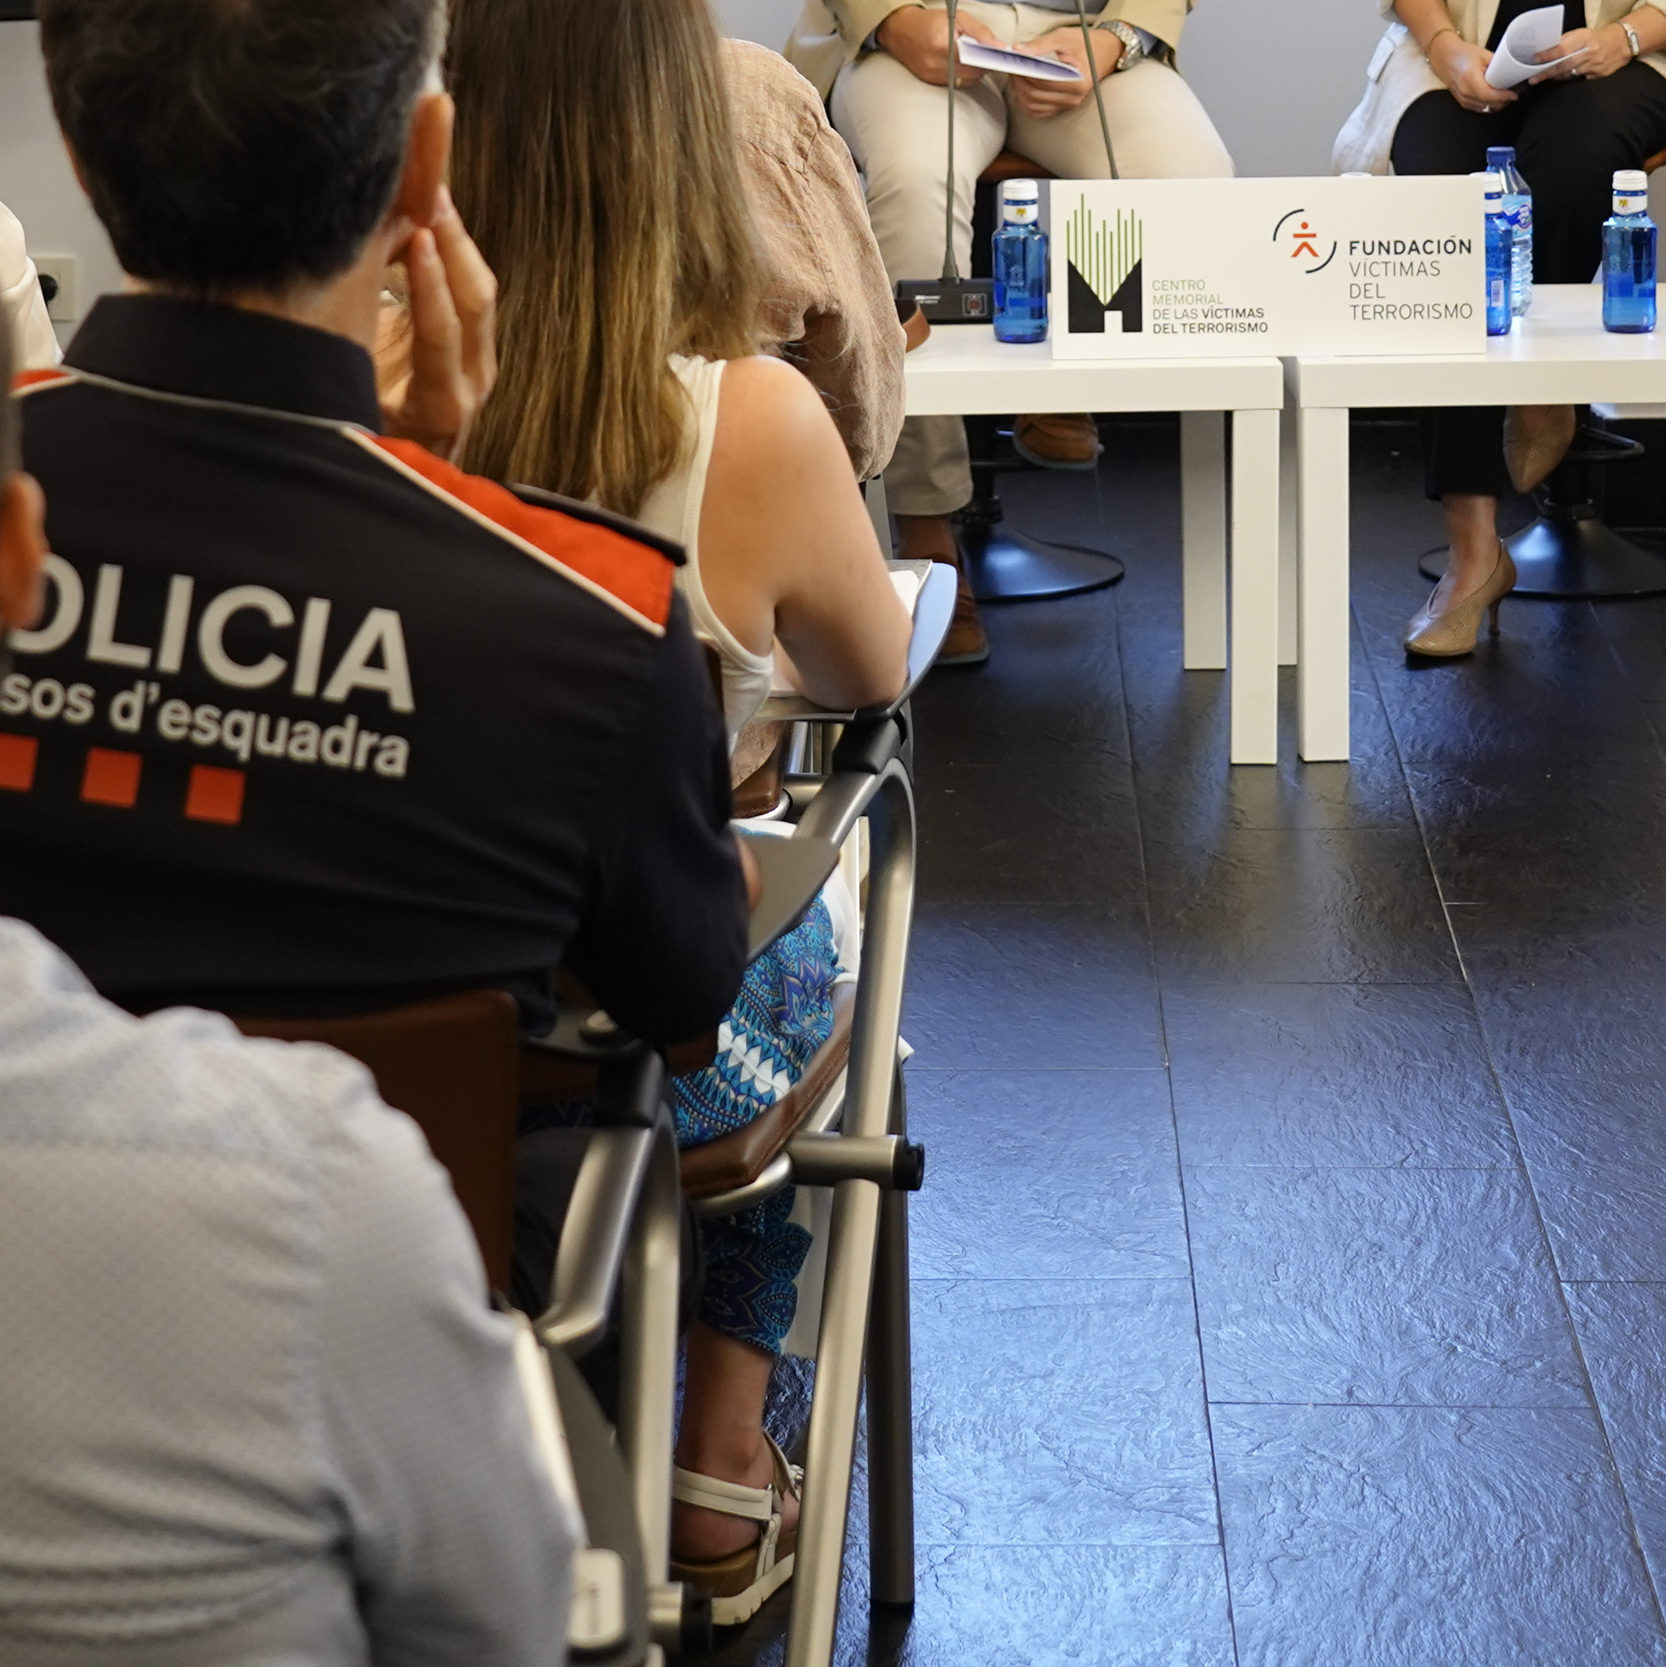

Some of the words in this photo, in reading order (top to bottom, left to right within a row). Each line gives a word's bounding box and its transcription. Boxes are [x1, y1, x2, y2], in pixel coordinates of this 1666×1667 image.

[1349, 235, 1472, 256] FUNDACIÓN
[1348, 258, 1441, 278] VÍCTIMAS
[1152, 279, 1206, 291] CENTRO
[1349, 282, 1387, 299] DEL
[1152, 293, 1225, 306] MEMORIAL
[1152, 308, 1171, 320] DE
[1174, 308, 1199, 320] LAS
[1201, 305, 1265, 319] VÍCTIMAS
[1349, 303, 1473, 321] TERRORISMO
[1152, 322, 1179, 334] DEL
[1180, 321, 1269, 334] TERRORISMO
[7, 551, 415, 713] OLICIA
